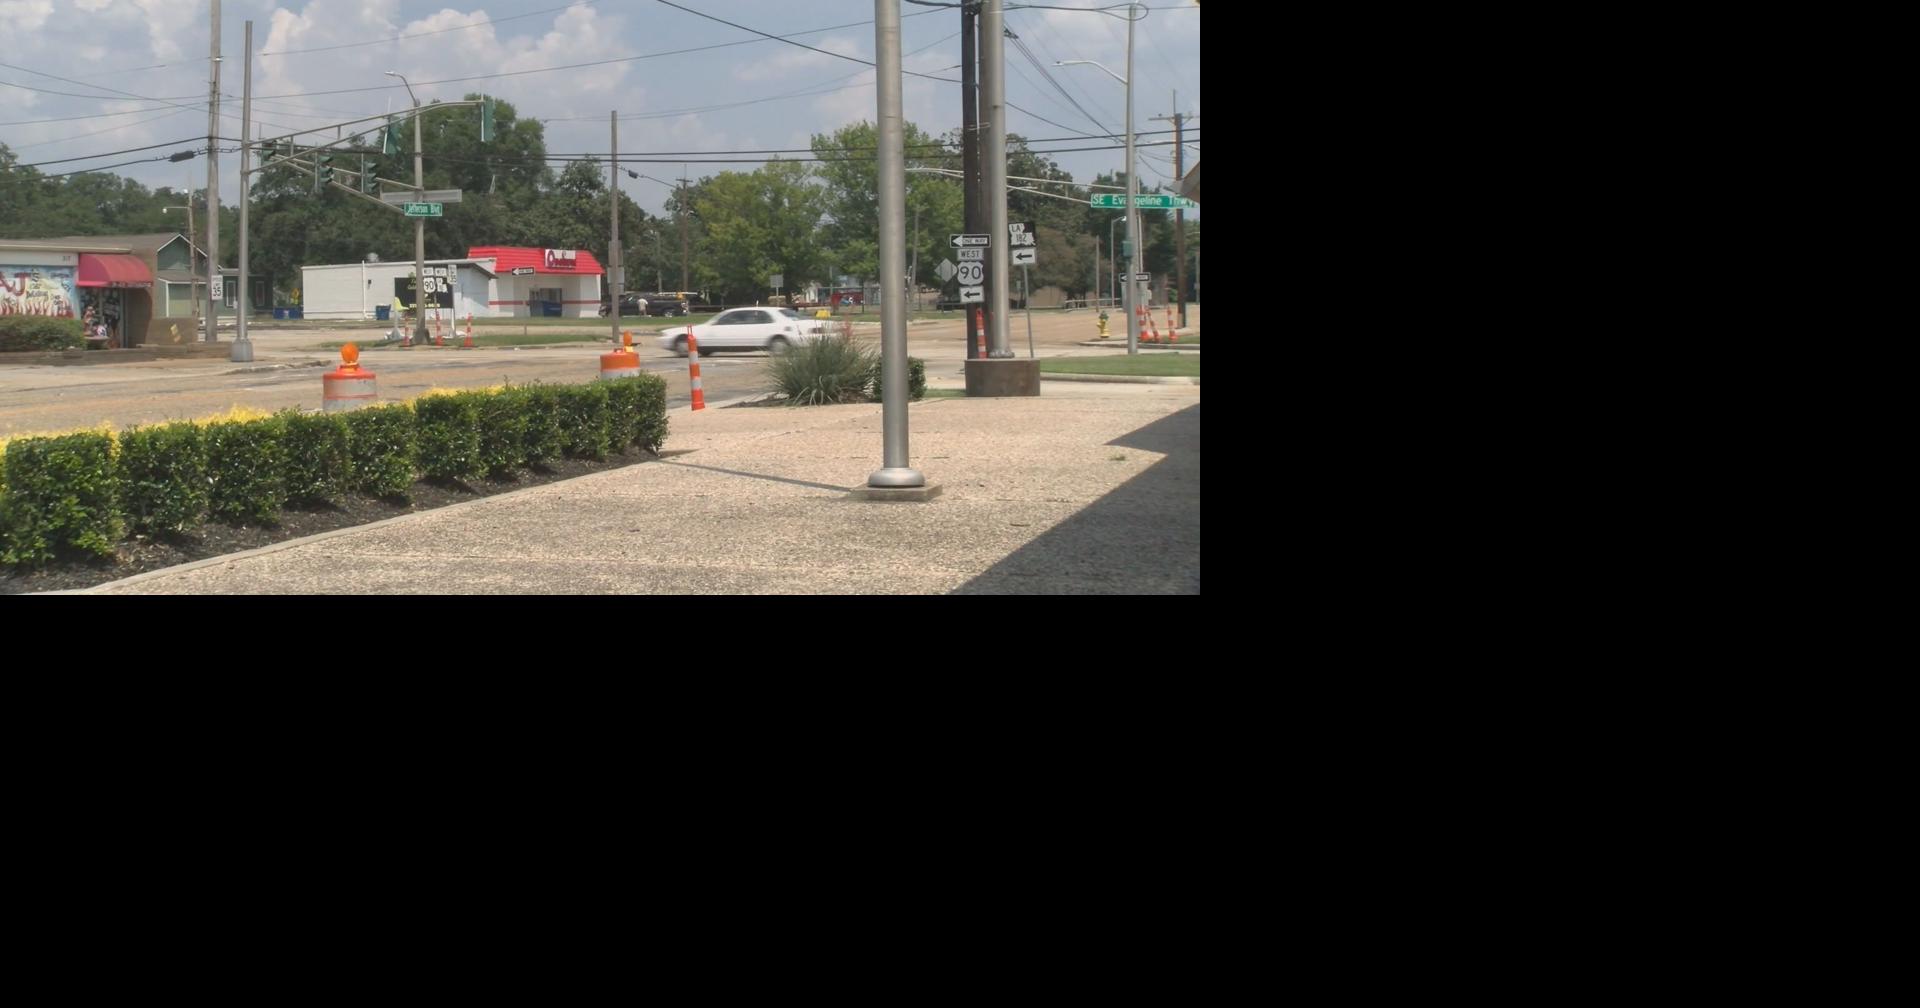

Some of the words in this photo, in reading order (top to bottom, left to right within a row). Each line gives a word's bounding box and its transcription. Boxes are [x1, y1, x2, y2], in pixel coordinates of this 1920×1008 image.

[1093, 194, 1104, 205] SE
[1112, 194, 1162, 208] Evgeline
[1011, 224, 1020, 233] LA
[960, 250, 980, 258] WEST
[960, 265, 981, 280] 90
[424, 281, 434, 290] 90
